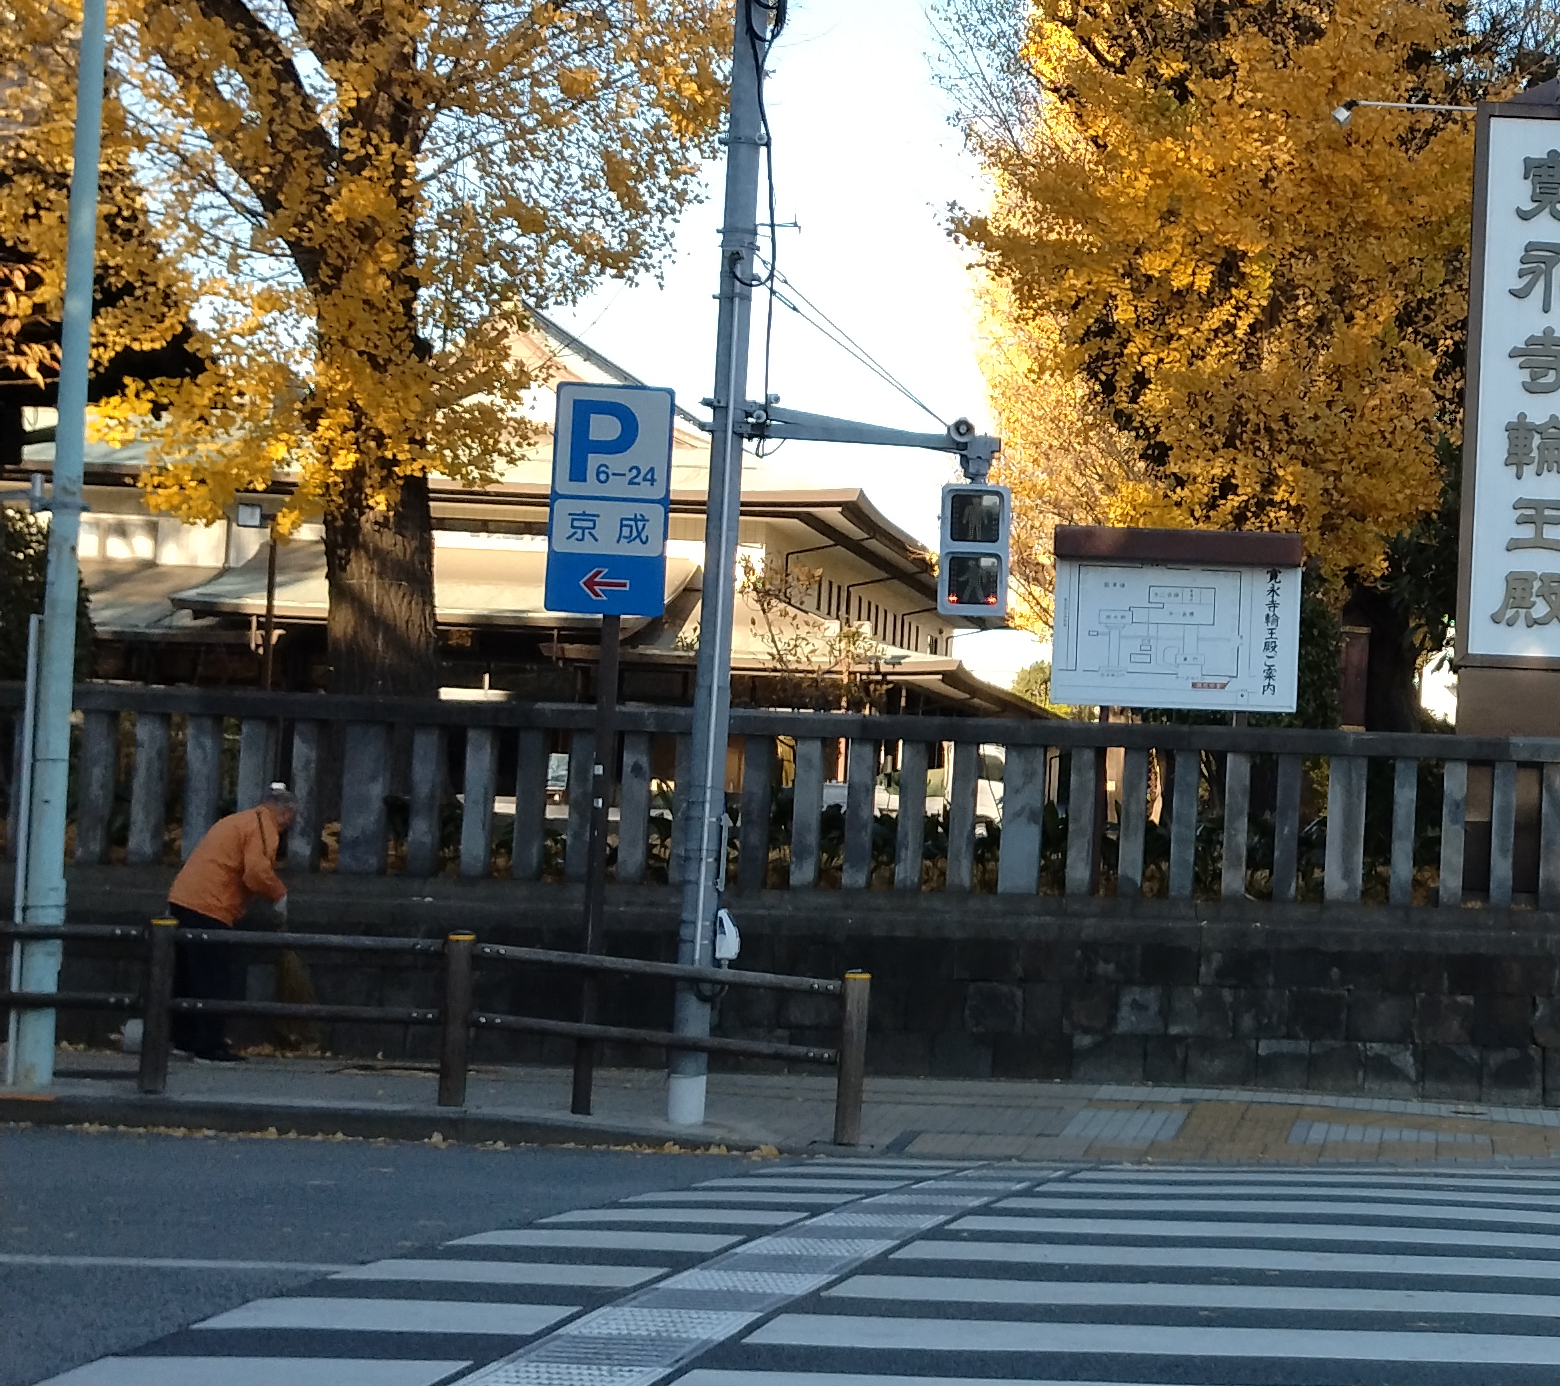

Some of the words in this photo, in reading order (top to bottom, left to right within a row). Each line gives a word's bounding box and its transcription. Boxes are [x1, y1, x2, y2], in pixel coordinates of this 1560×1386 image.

[568, 398, 640, 483] P
[595, 463, 658, 487] 6-24
[566, 510, 650, 545] 京成
[1261, 567, 1283, 697] 寛永寺輪王殿ご案内
